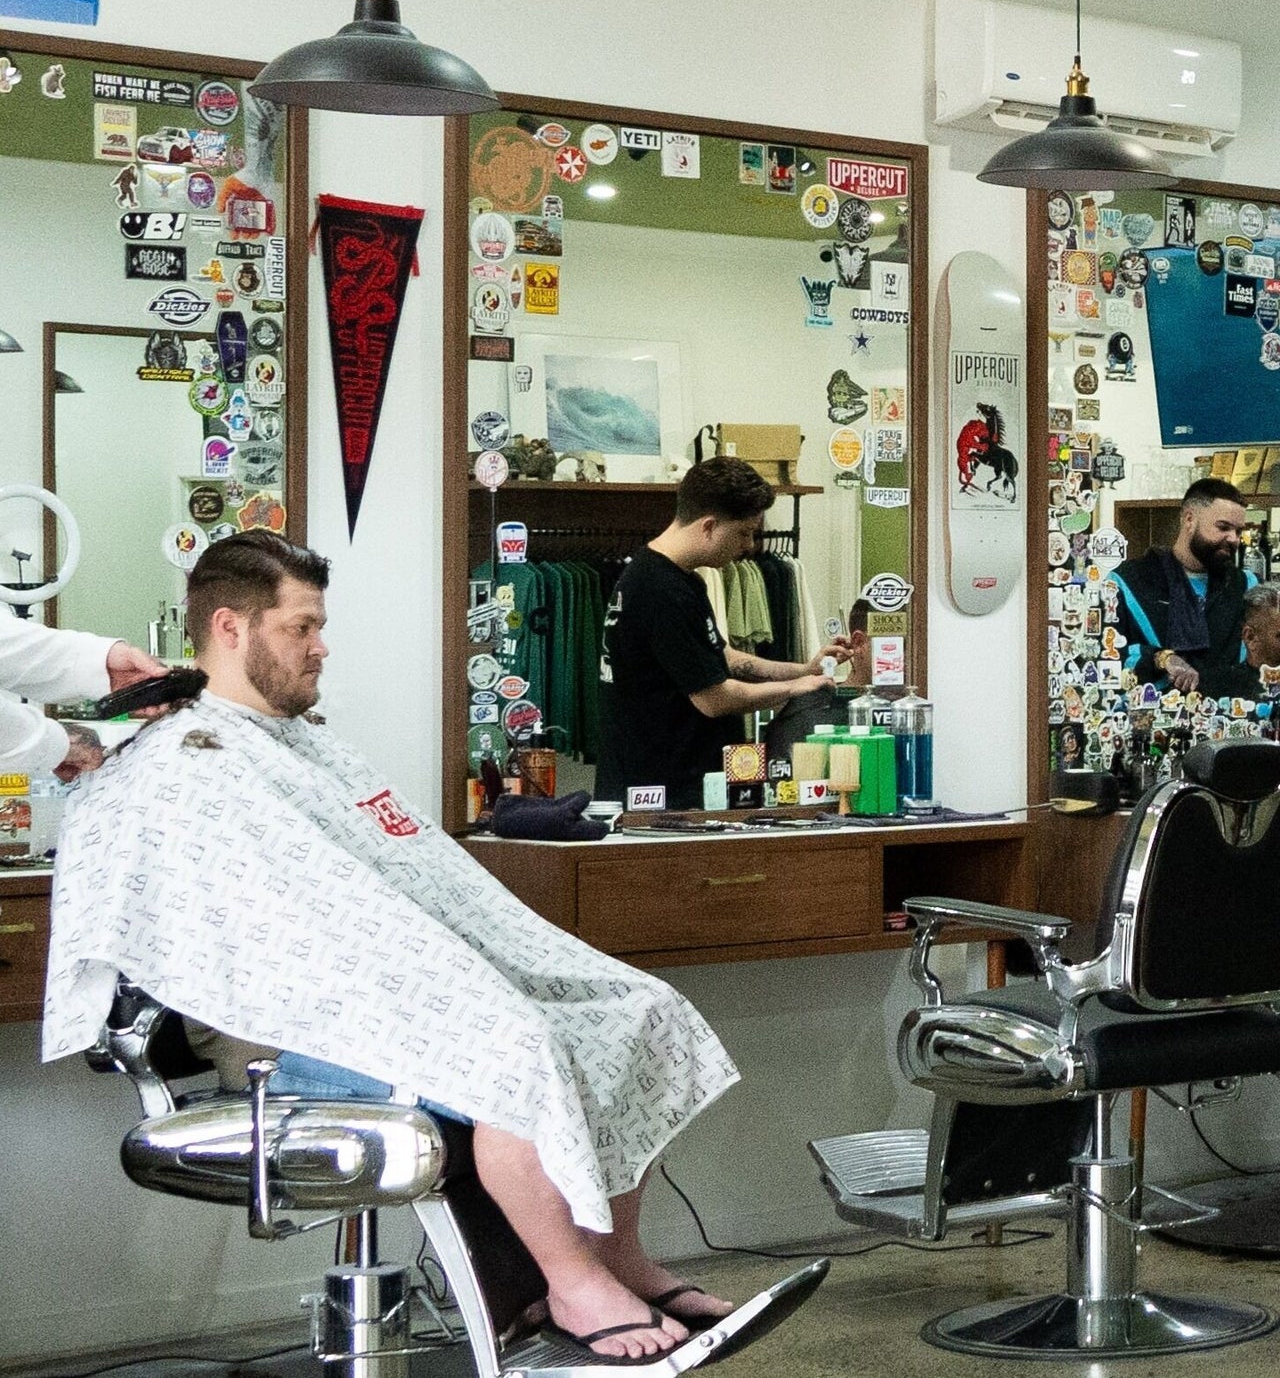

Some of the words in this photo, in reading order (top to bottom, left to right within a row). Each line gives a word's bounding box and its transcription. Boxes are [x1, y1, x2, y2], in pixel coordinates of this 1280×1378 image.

[95, 73, 122, 86] WOMEN
[126, 76, 147, 88] WANT
[151, 80, 161, 90] ME
[95, 84, 117, 96] FISH
[120, 87, 144, 100] FEAR
[147, 89, 161, 102] ME
[624, 131, 658, 146] YETI
[831, 161, 905, 194] UPPERCUT
[270, 238, 284, 297] UPPERCUT
[1236, 284, 1254, 294] Fast
[1228, 291, 1254, 304] Times
[154, 301, 206, 312] Dickies
[852, 307, 909, 323] COWBOYS
[955, 355, 1018, 387] UPPERCUT
[868, 489, 908, 502] UPPERCUT
[1093, 537, 1108, 546] FAST
[1092, 547, 1113, 555] TIMES
[870, 588, 907, 596] Dickies
[634, 792, 662, 805] BALI
